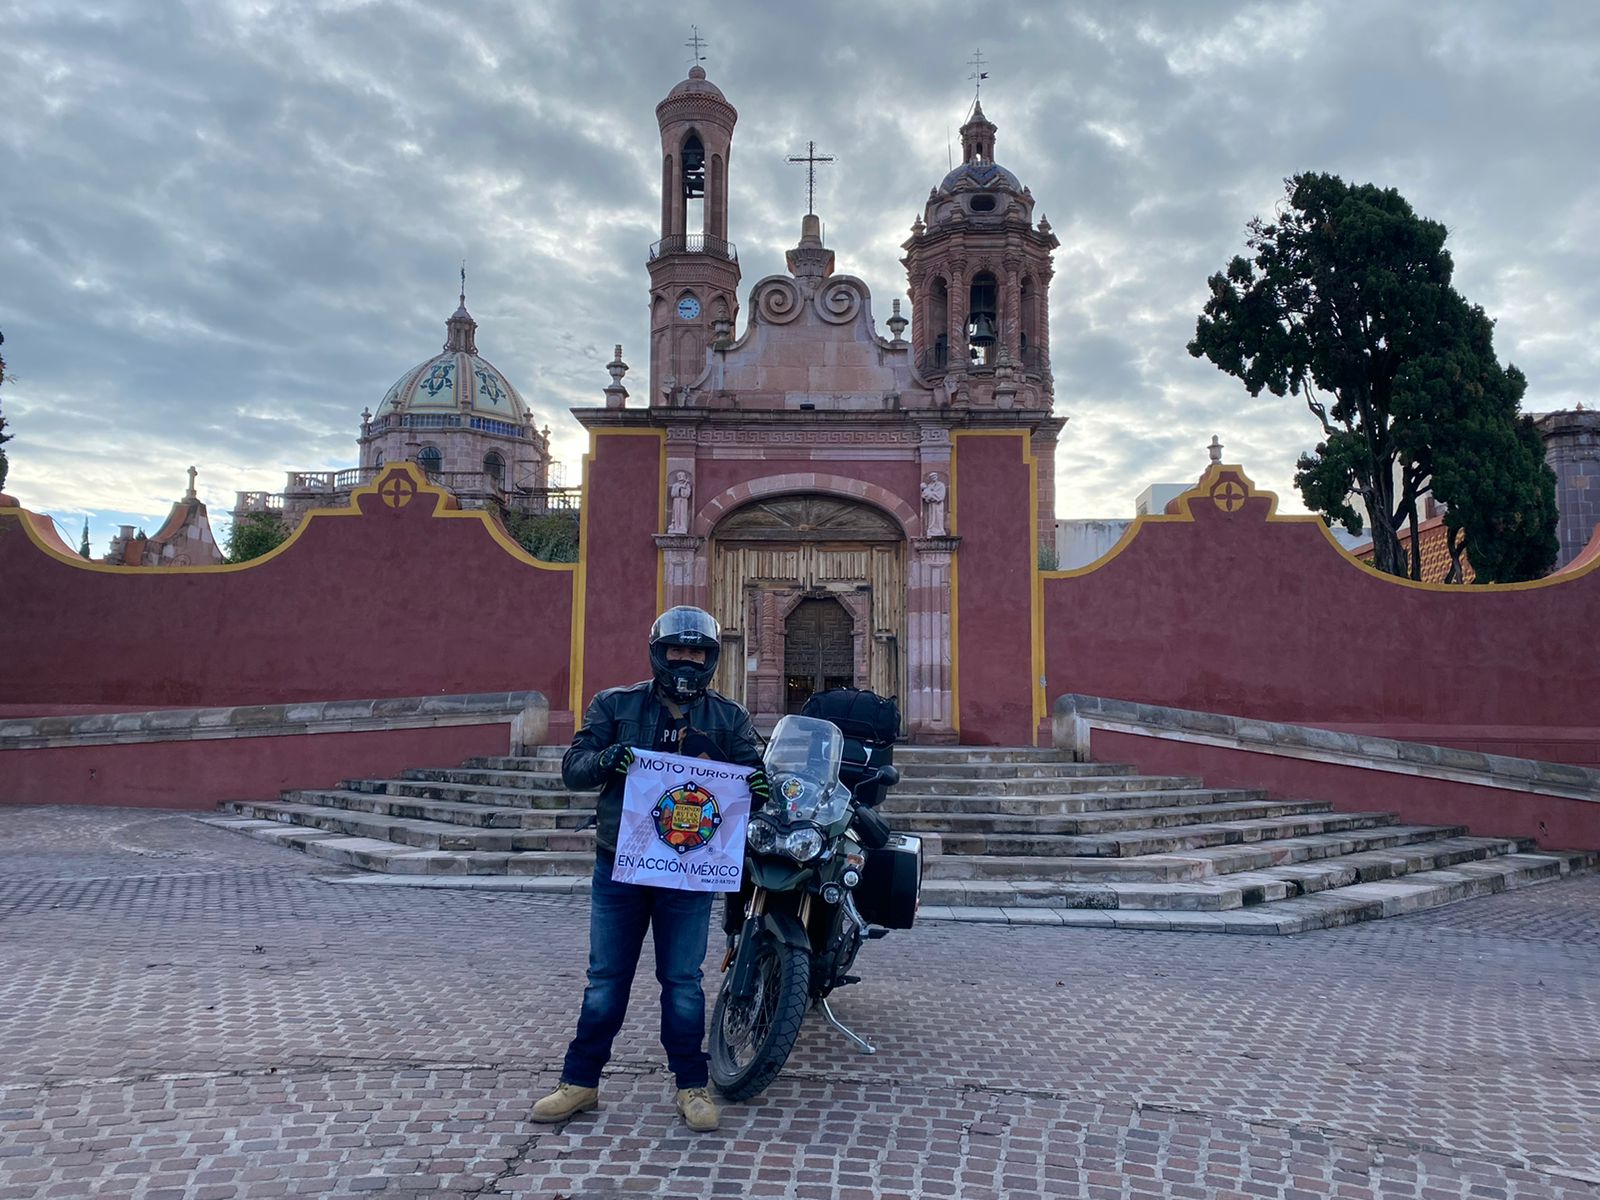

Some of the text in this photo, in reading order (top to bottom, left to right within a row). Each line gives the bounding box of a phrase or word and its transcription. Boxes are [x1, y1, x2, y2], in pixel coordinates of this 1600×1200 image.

[640, 757, 685, 774] MOTO
[618, 854, 740, 877] EN ACCIÓN MÉXICO
